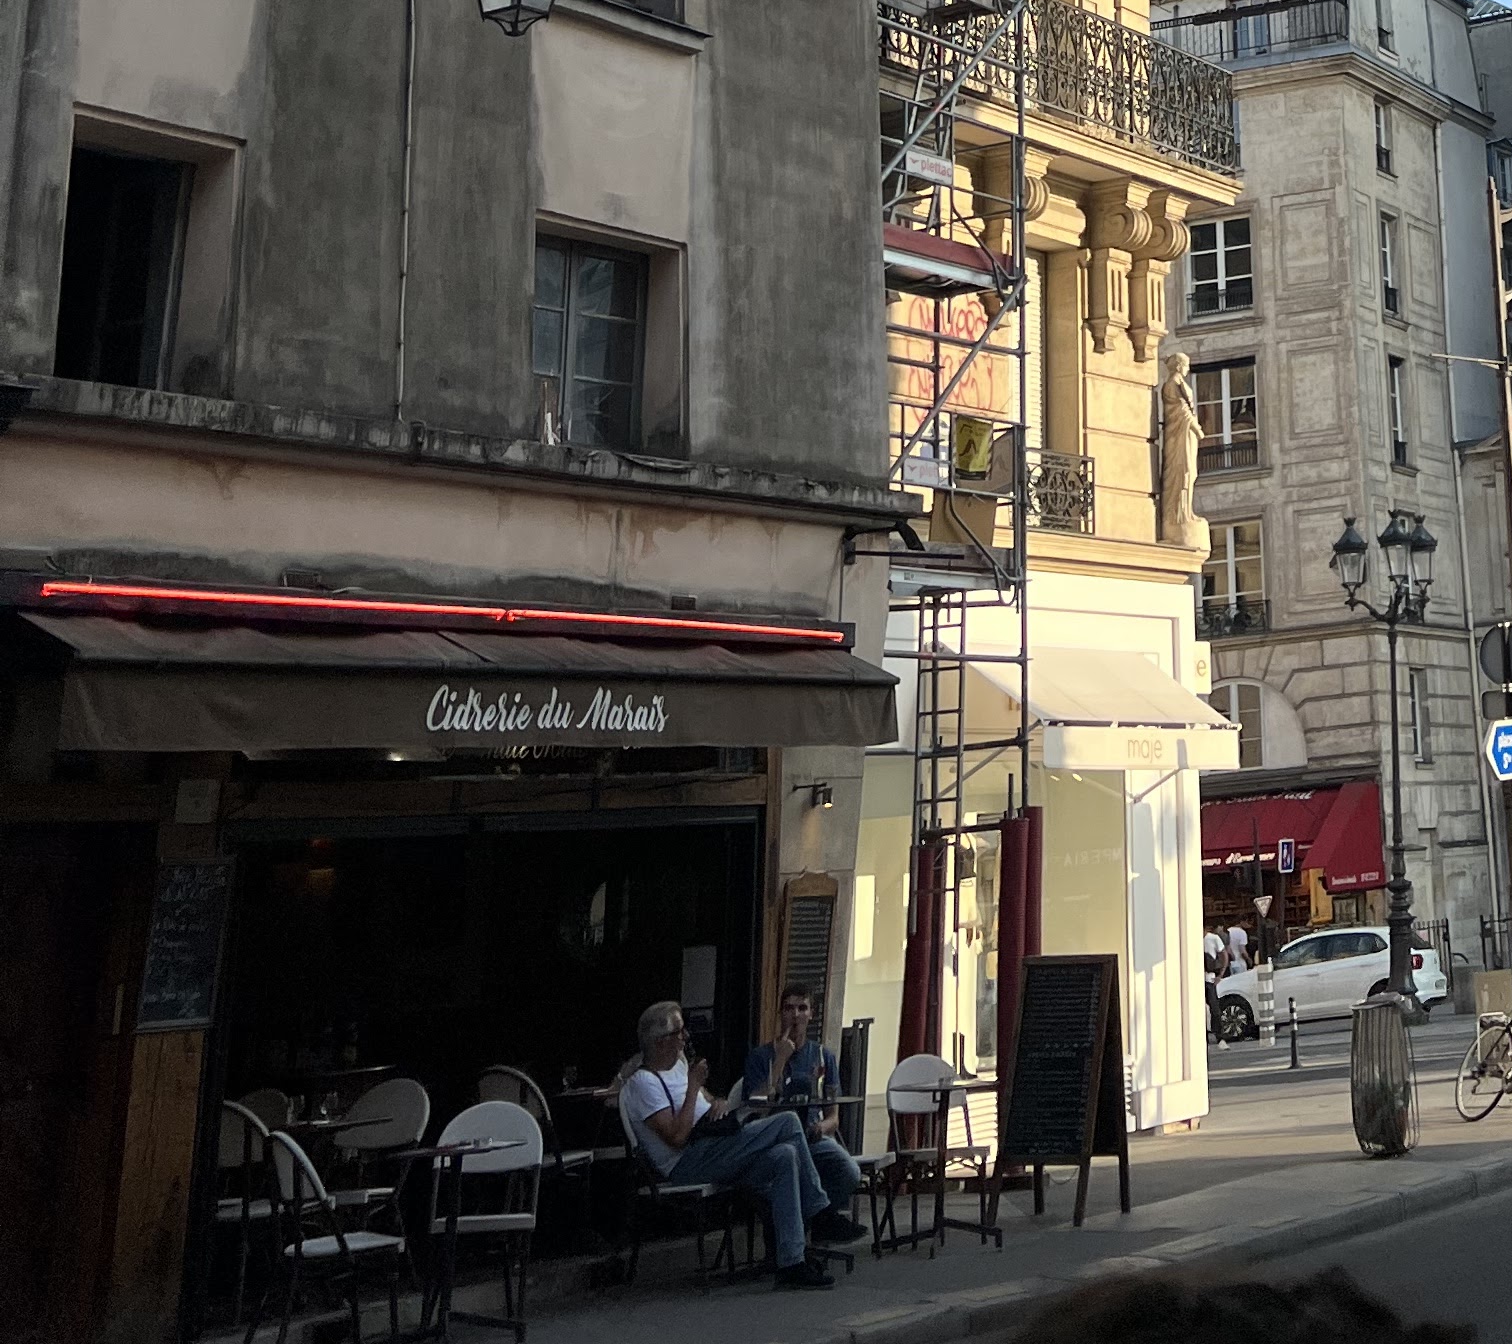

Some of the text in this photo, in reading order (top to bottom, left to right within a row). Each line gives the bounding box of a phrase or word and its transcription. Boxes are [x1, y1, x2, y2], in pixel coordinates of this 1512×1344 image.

[920, 157, 952, 178] plettac
[426, 684, 670, 732] Cidrerie du Marais
[1127, 739, 1163, 763] maje
